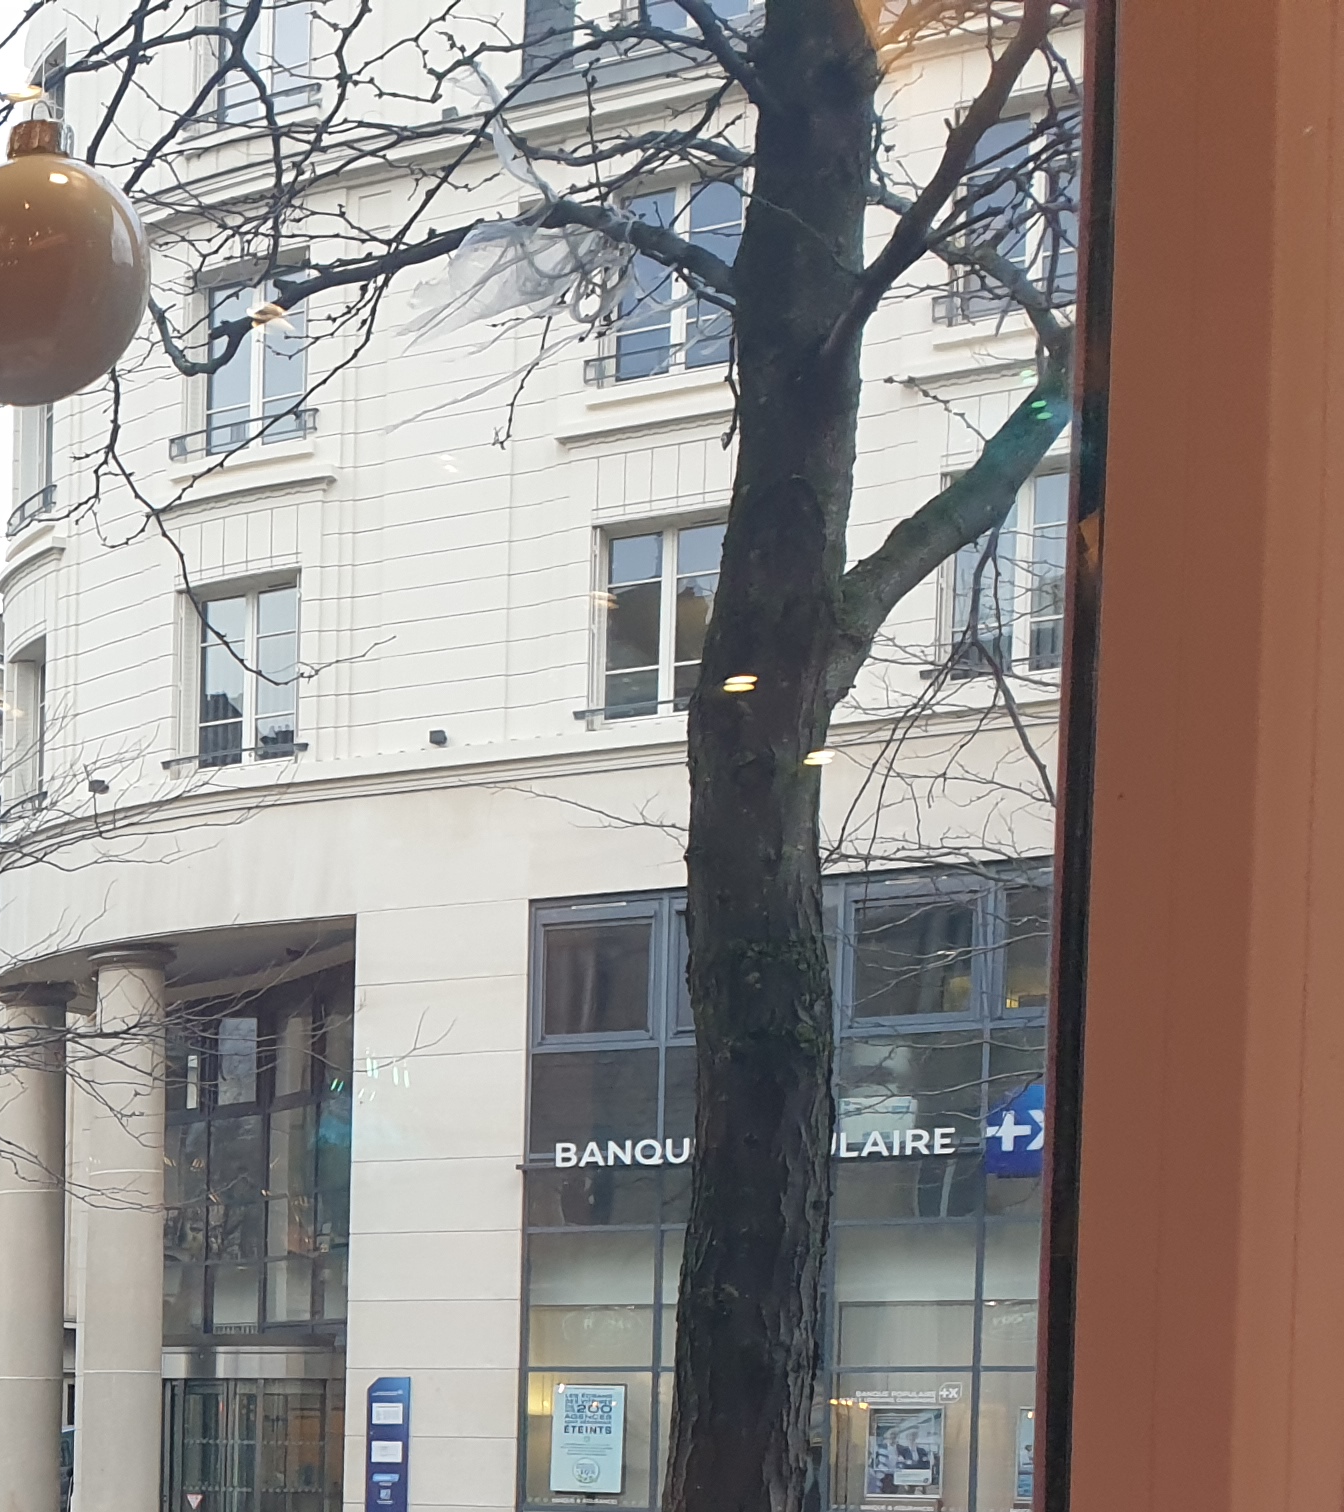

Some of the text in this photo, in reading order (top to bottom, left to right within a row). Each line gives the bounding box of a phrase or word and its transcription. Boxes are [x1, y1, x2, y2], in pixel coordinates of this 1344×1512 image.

[555, 1137, 696, 1168] BANQU
[576, 1404, 613, 1414] 200
[563, 1424, 612, 1435] ÉTEINTS
